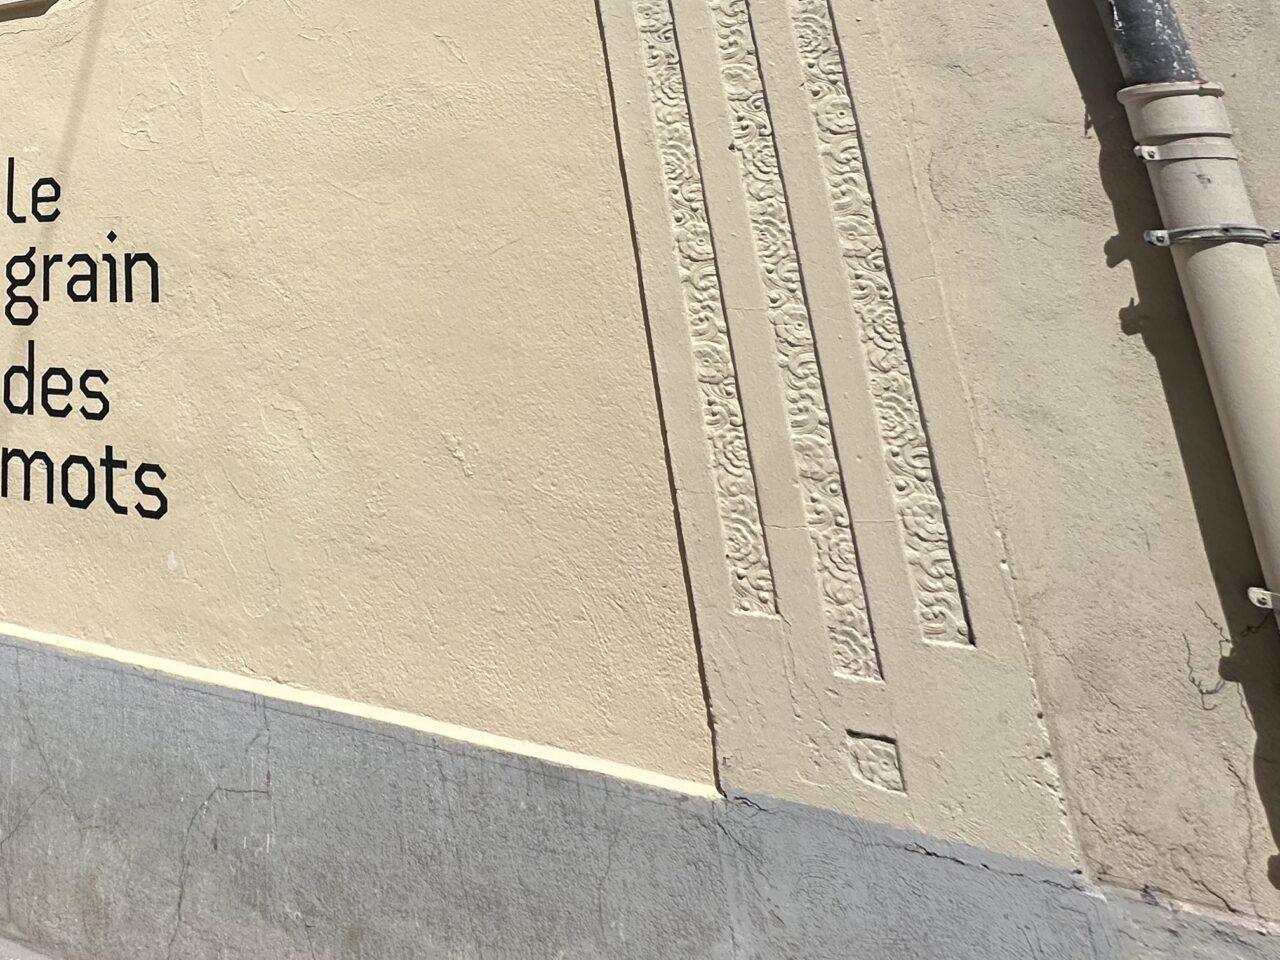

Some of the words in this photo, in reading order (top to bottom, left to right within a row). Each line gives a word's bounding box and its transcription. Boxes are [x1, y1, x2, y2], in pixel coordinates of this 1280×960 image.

[6, 157, 62, 224] le
[4, 230, 160, 326] grain
[3, 340, 110, 422] des
[0, 445, 169, 520] mots
